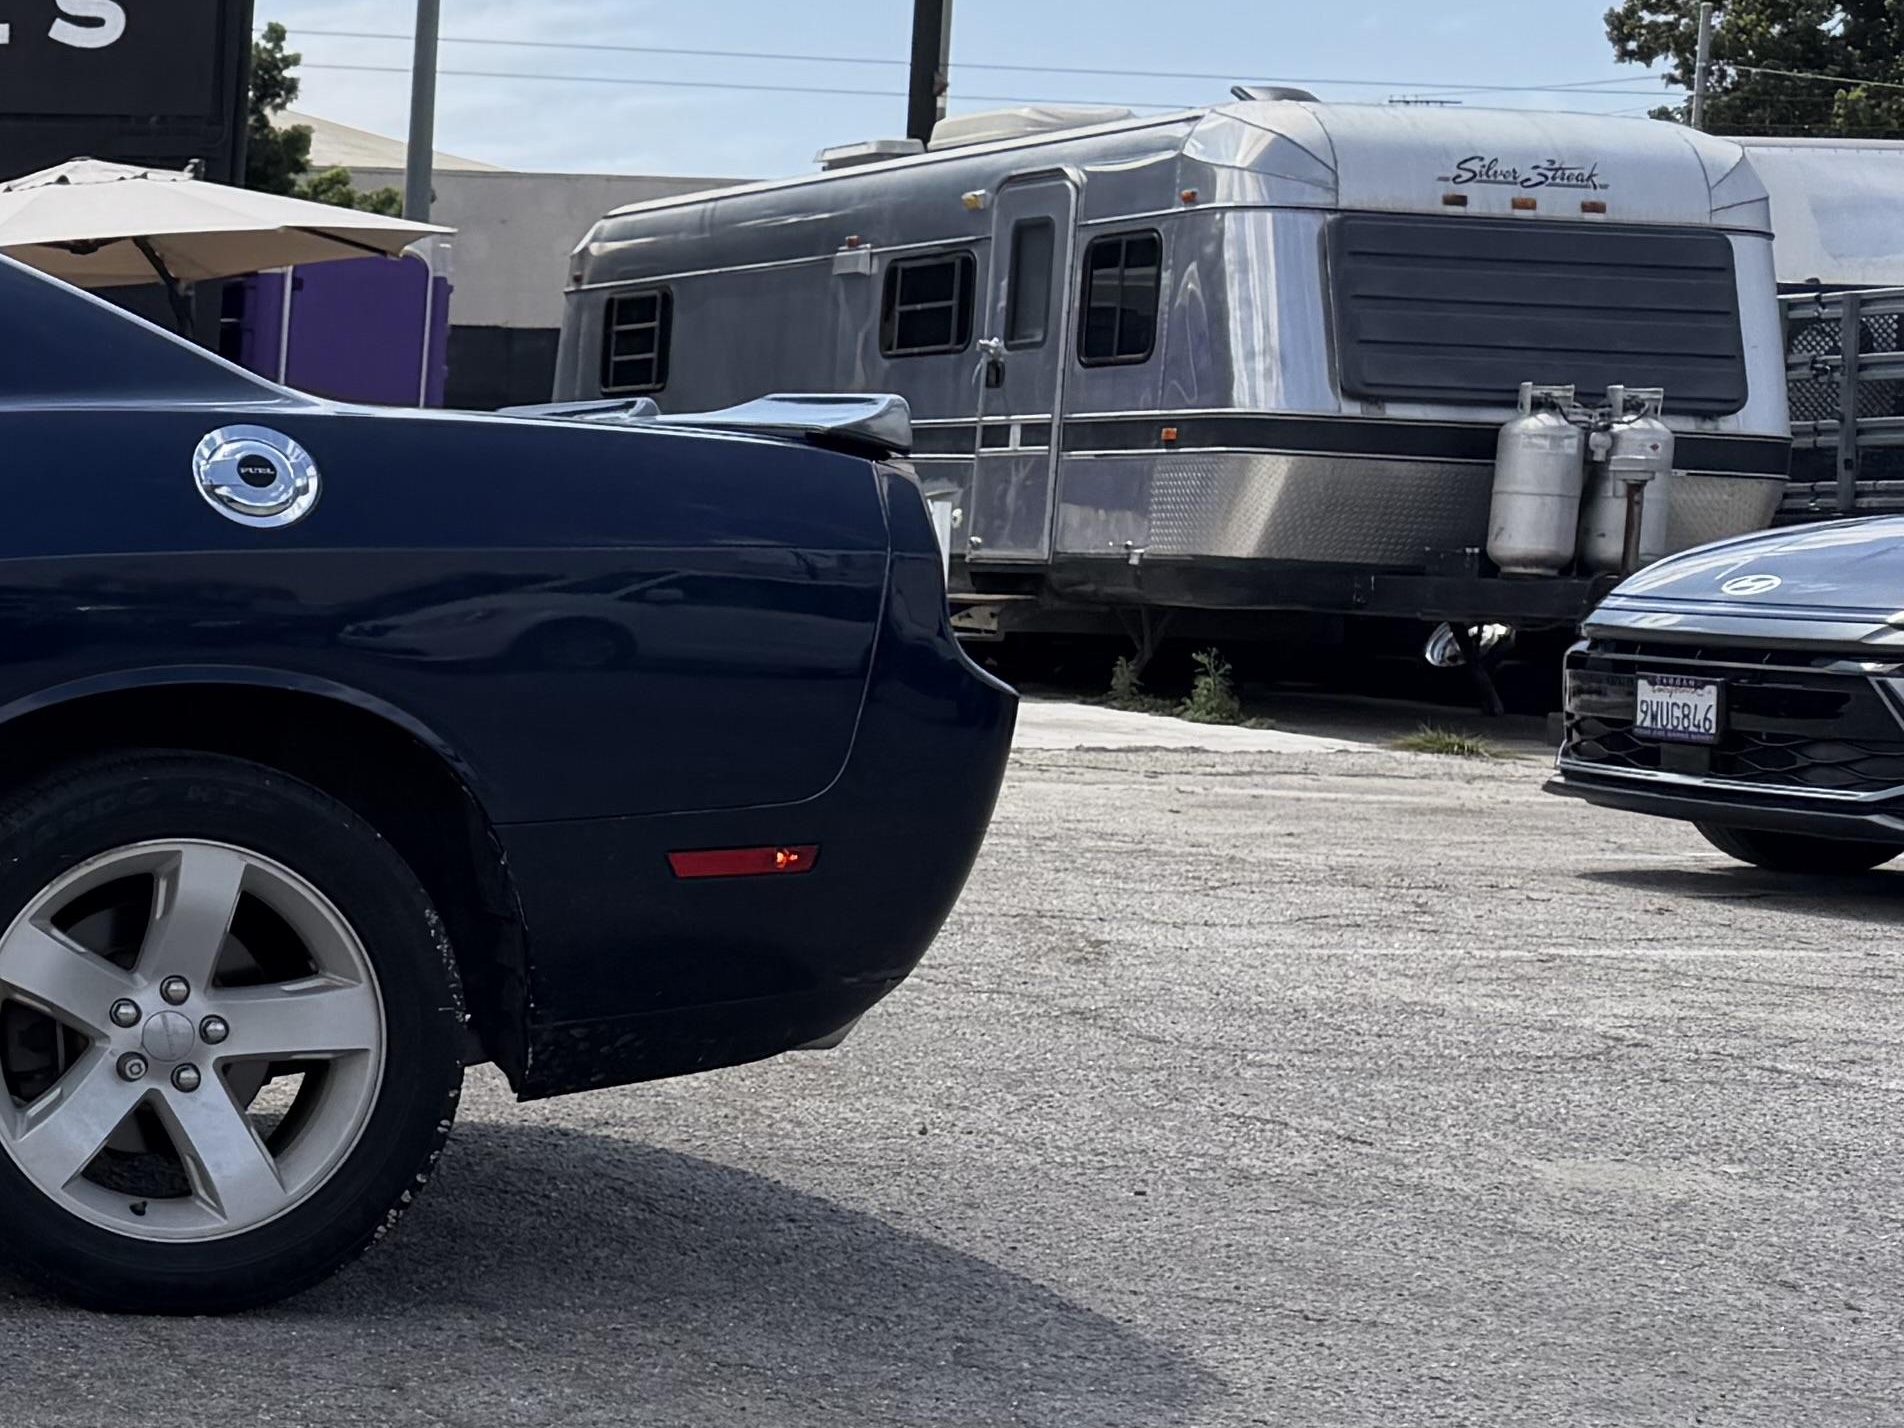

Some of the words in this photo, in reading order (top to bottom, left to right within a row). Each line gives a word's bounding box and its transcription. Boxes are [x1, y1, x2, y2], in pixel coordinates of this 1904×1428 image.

[1452, 155, 1521, 185] Silver
[1520, 159, 1599, 190] Streak
[1640, 699, 1713, 733] 9WUG846
